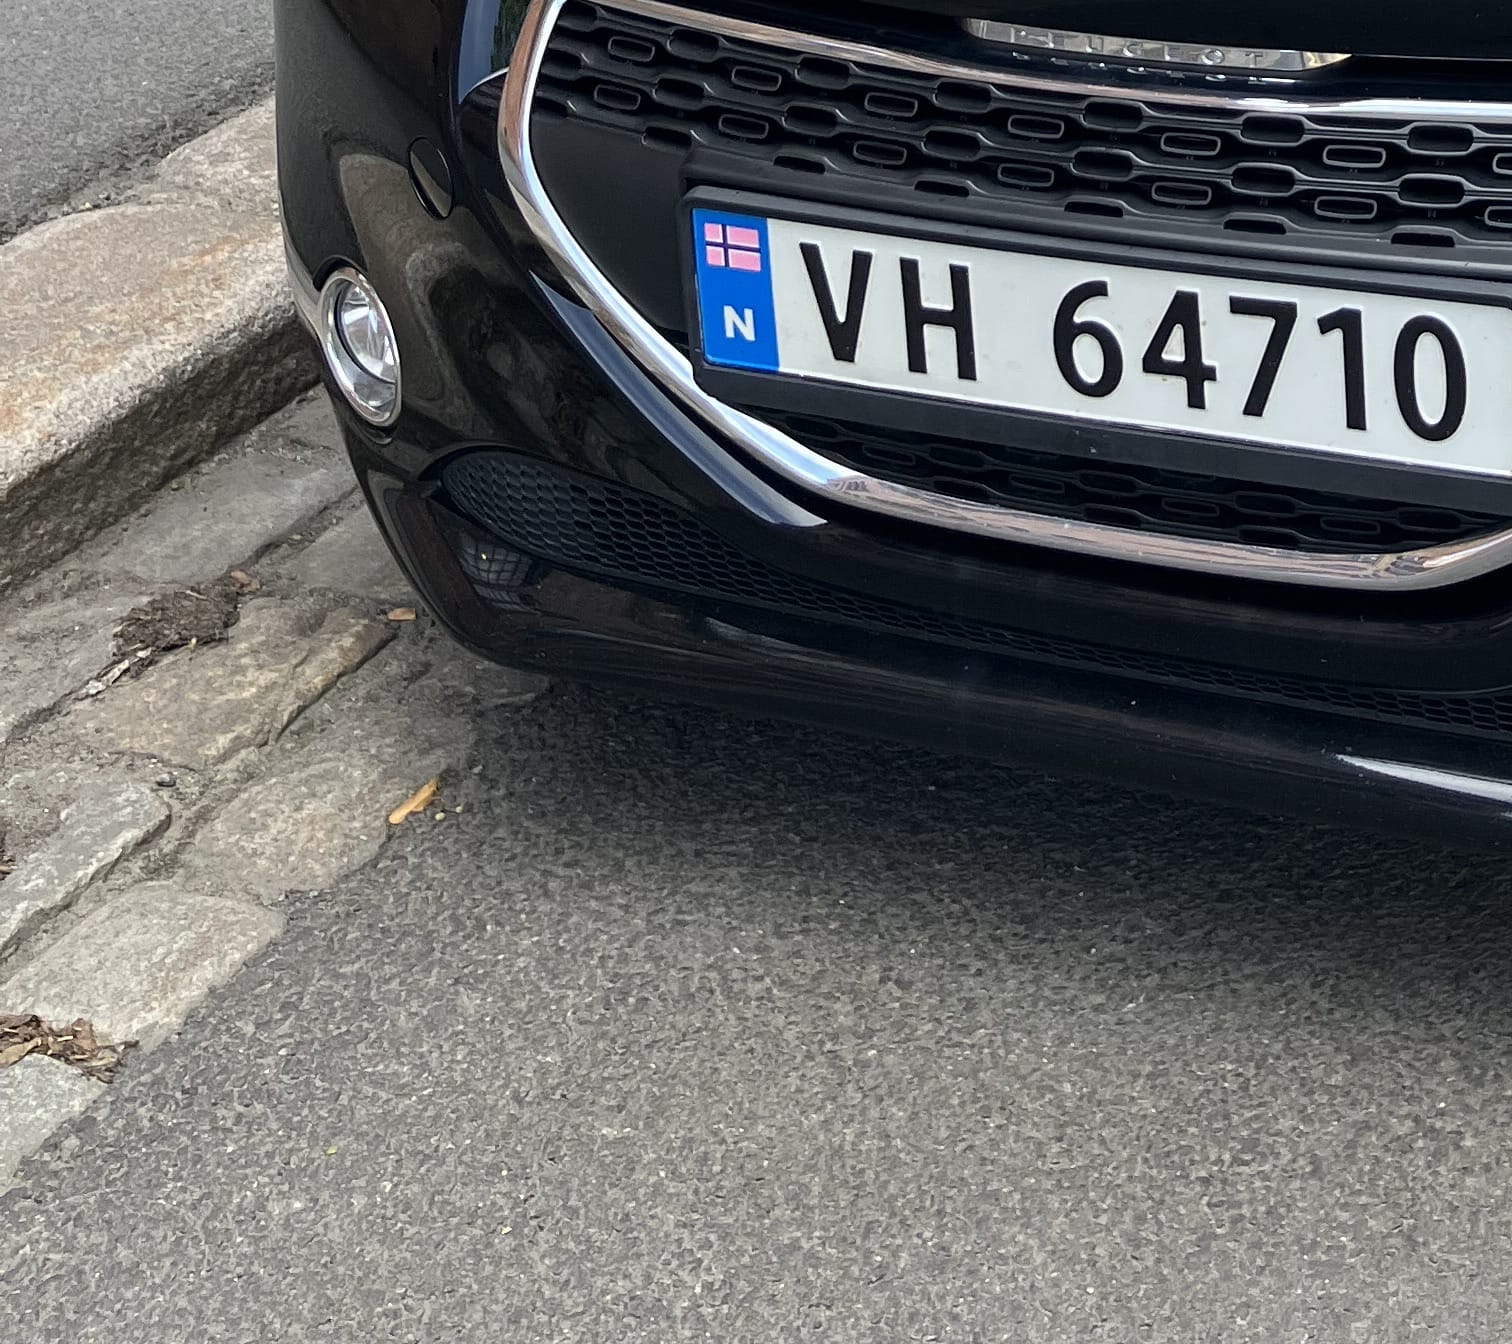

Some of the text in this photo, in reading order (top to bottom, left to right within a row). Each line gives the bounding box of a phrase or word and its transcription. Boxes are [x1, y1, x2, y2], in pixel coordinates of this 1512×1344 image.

[722, 306, 756, 341] N
[799, 241, 1469, 443] VH 64710
